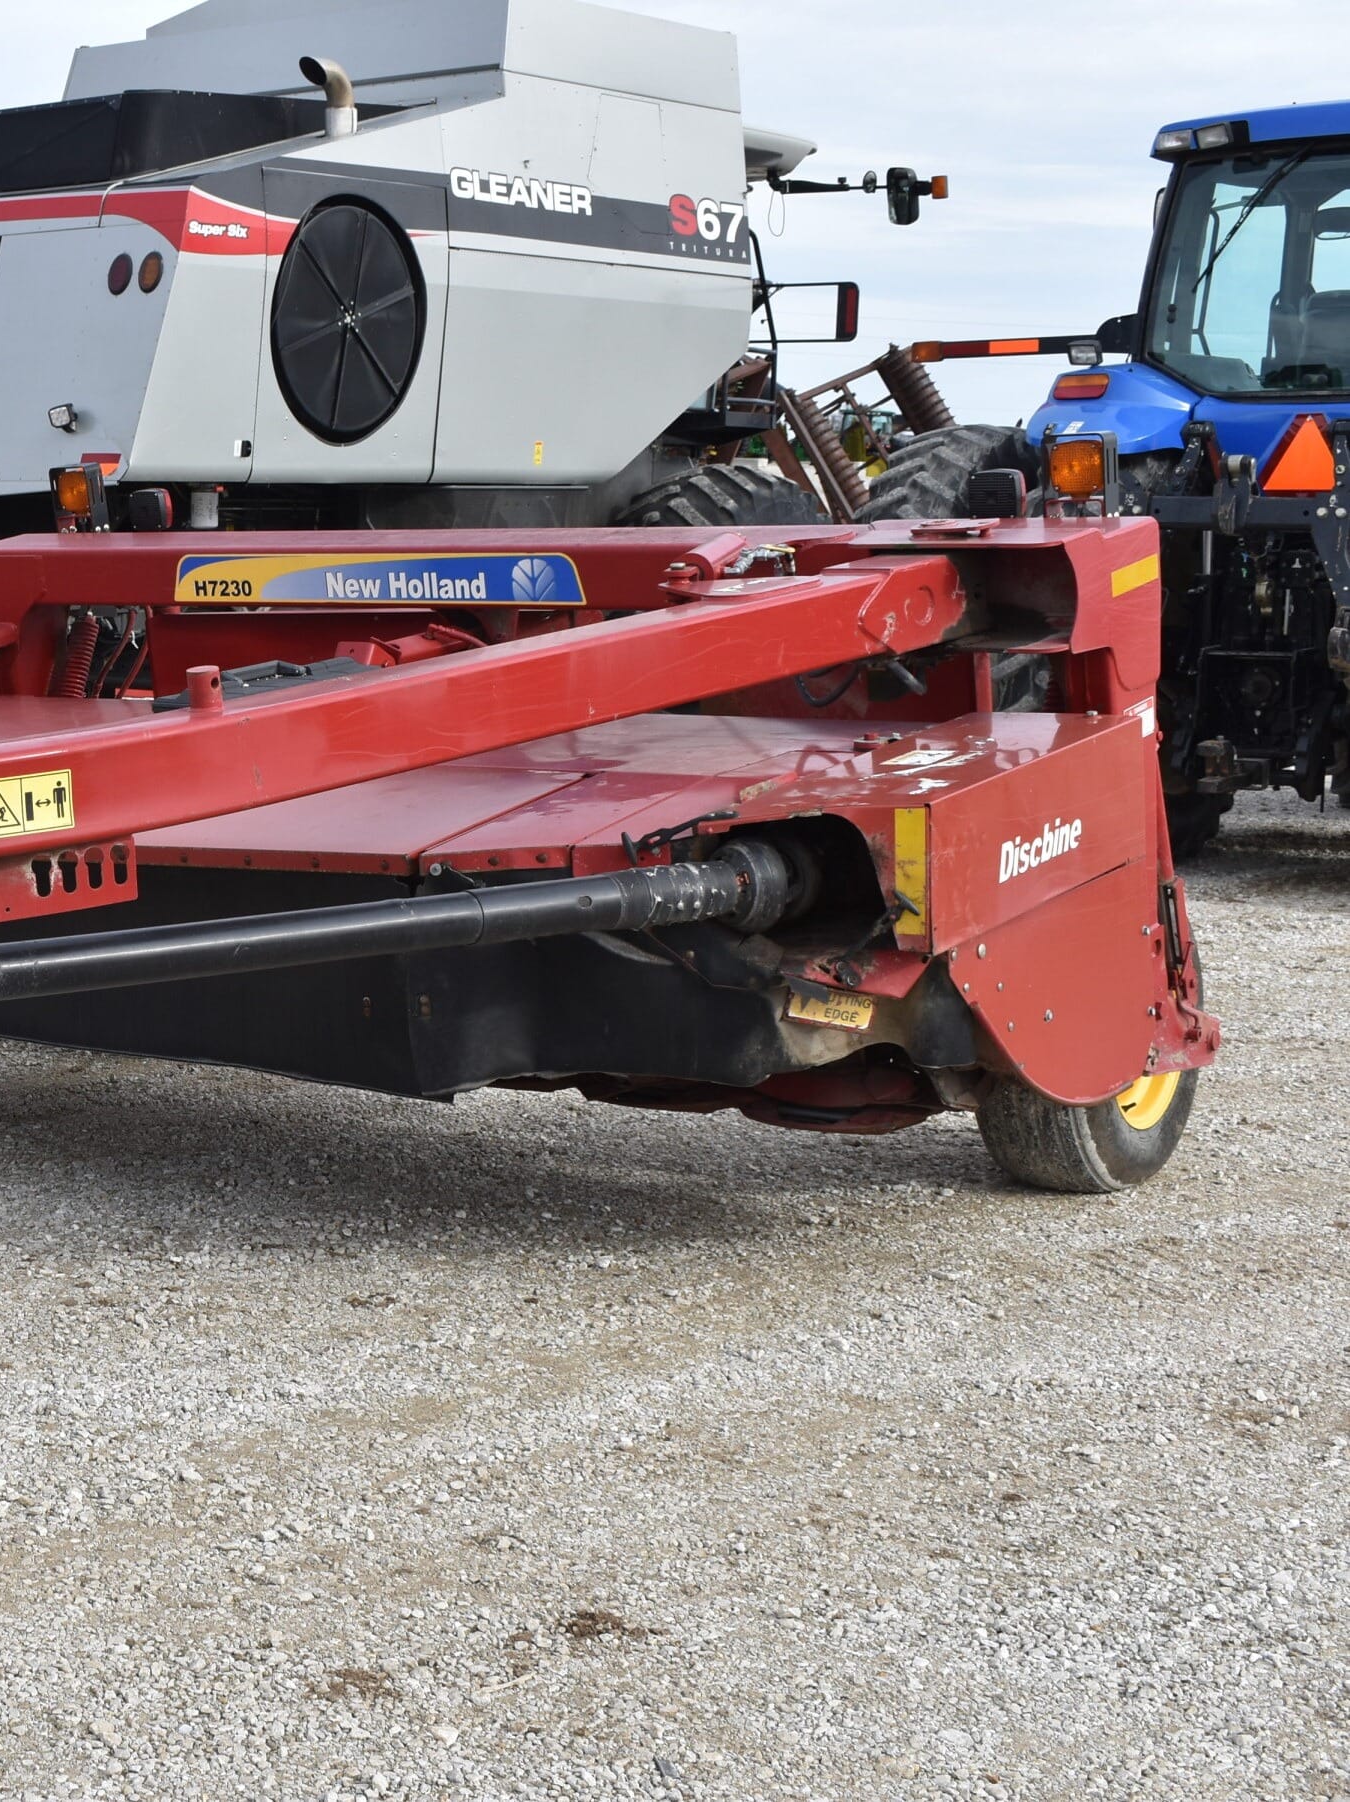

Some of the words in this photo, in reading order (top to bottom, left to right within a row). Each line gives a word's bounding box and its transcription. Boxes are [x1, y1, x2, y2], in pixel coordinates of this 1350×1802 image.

[450, 167, 593, 216] GLEANER
[188, 220, 227, 238] Super
[227, 224, 249, 239] Six
[668, 193, 744, 243] S67
[669, 241, 747, 259] TRITURA
[194, 580, 252, 597] H7230
[325, 571, 381, 599] New
[388, 571, 487, 599] Holland
[998, 817, 1082, 884] Discbine
[824, 1007, 858, 1022] EDGE
